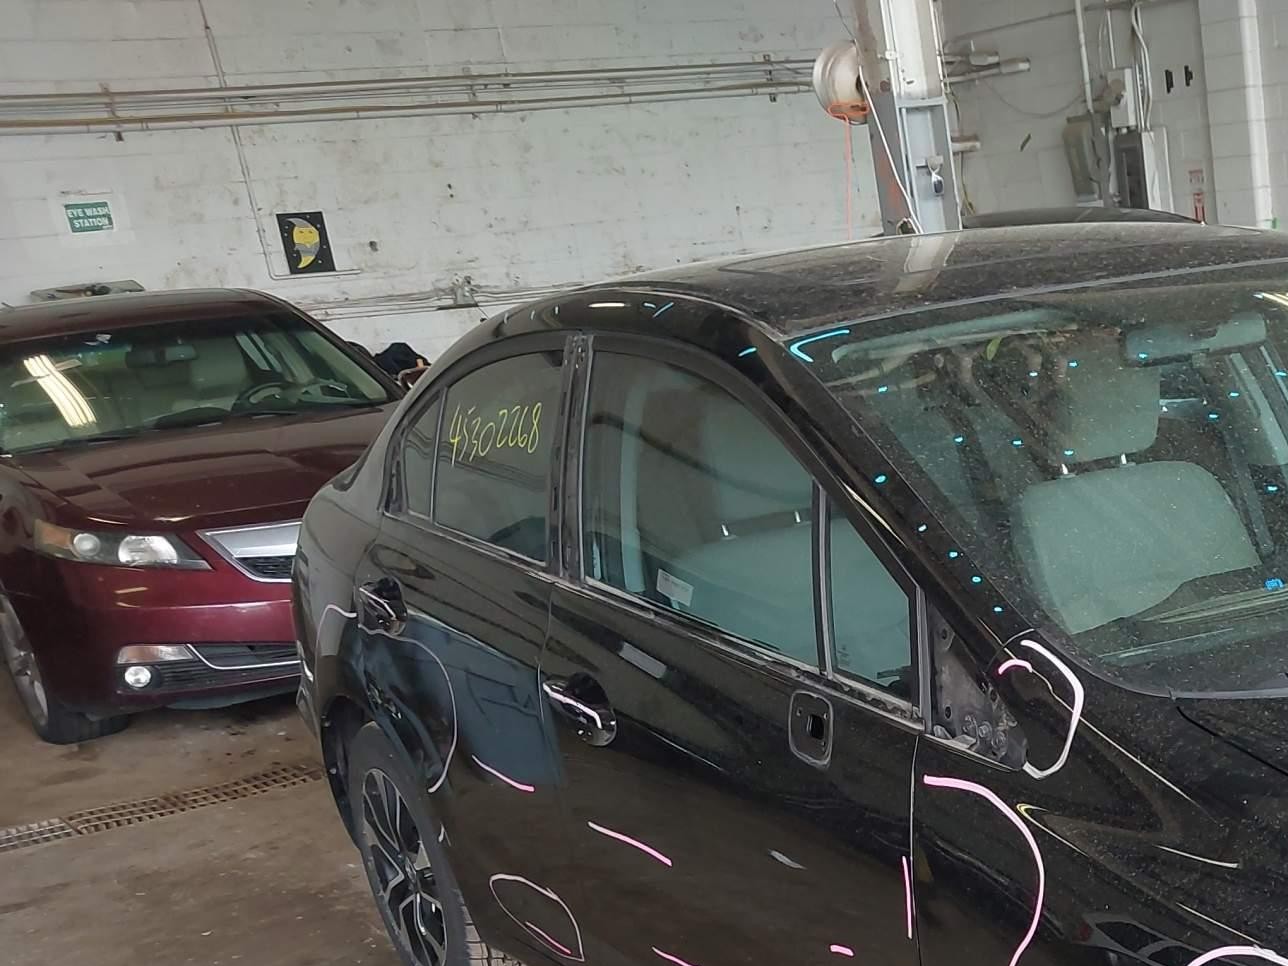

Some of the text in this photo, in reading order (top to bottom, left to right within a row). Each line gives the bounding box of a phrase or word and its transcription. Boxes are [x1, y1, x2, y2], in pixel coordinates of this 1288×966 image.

[66, 206, 110, 218] EYE WASH
[73, 217, 109, 228] STATION
[448, 402, 542, 467] 45302268
